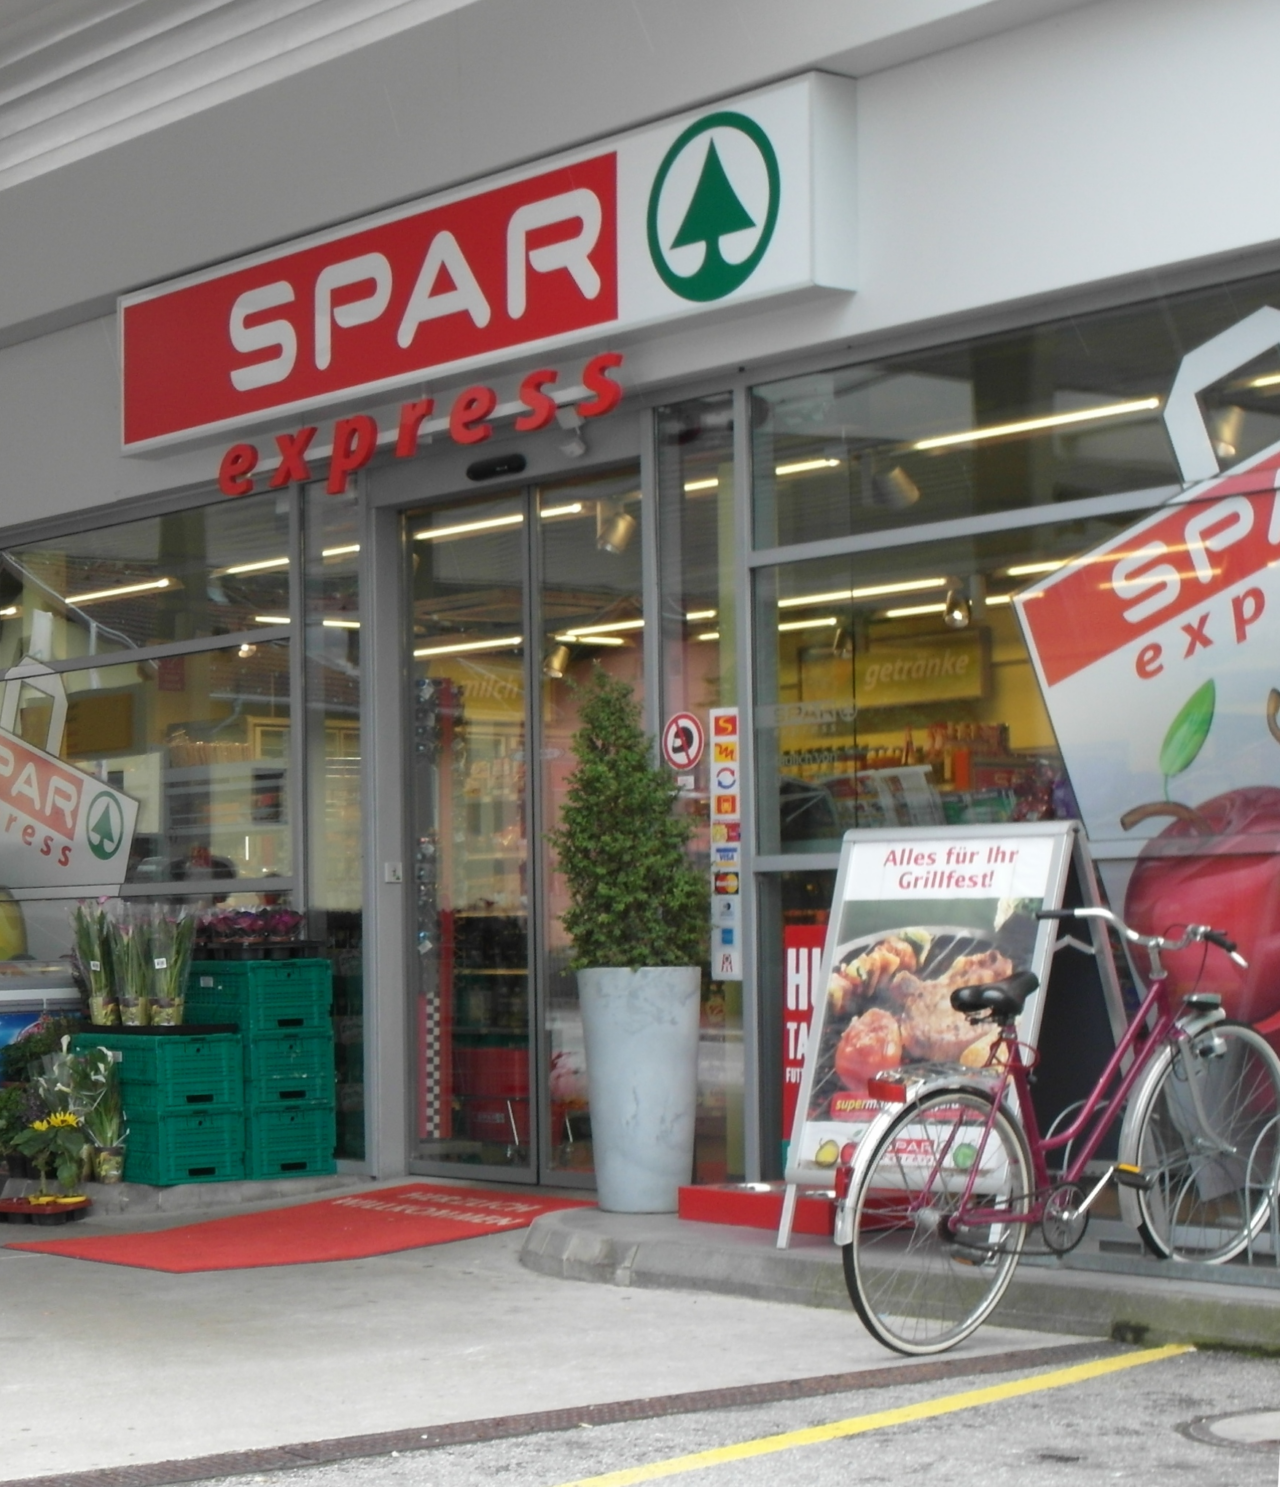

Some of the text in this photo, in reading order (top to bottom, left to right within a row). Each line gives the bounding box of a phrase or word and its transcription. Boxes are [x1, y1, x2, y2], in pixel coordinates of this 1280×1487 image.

[228, 187, 602, 391] SPAR
[217, 351, 624, 496] express
[864, 652, 969, 690] getränke
[463, 674, 517, 699] milch
[884, 846, 1019, 867] Alles für Ihr
[898, 870, 995, 890] Grillfest!
[331, 1197, 525, 1226] WILLKOMMEN
